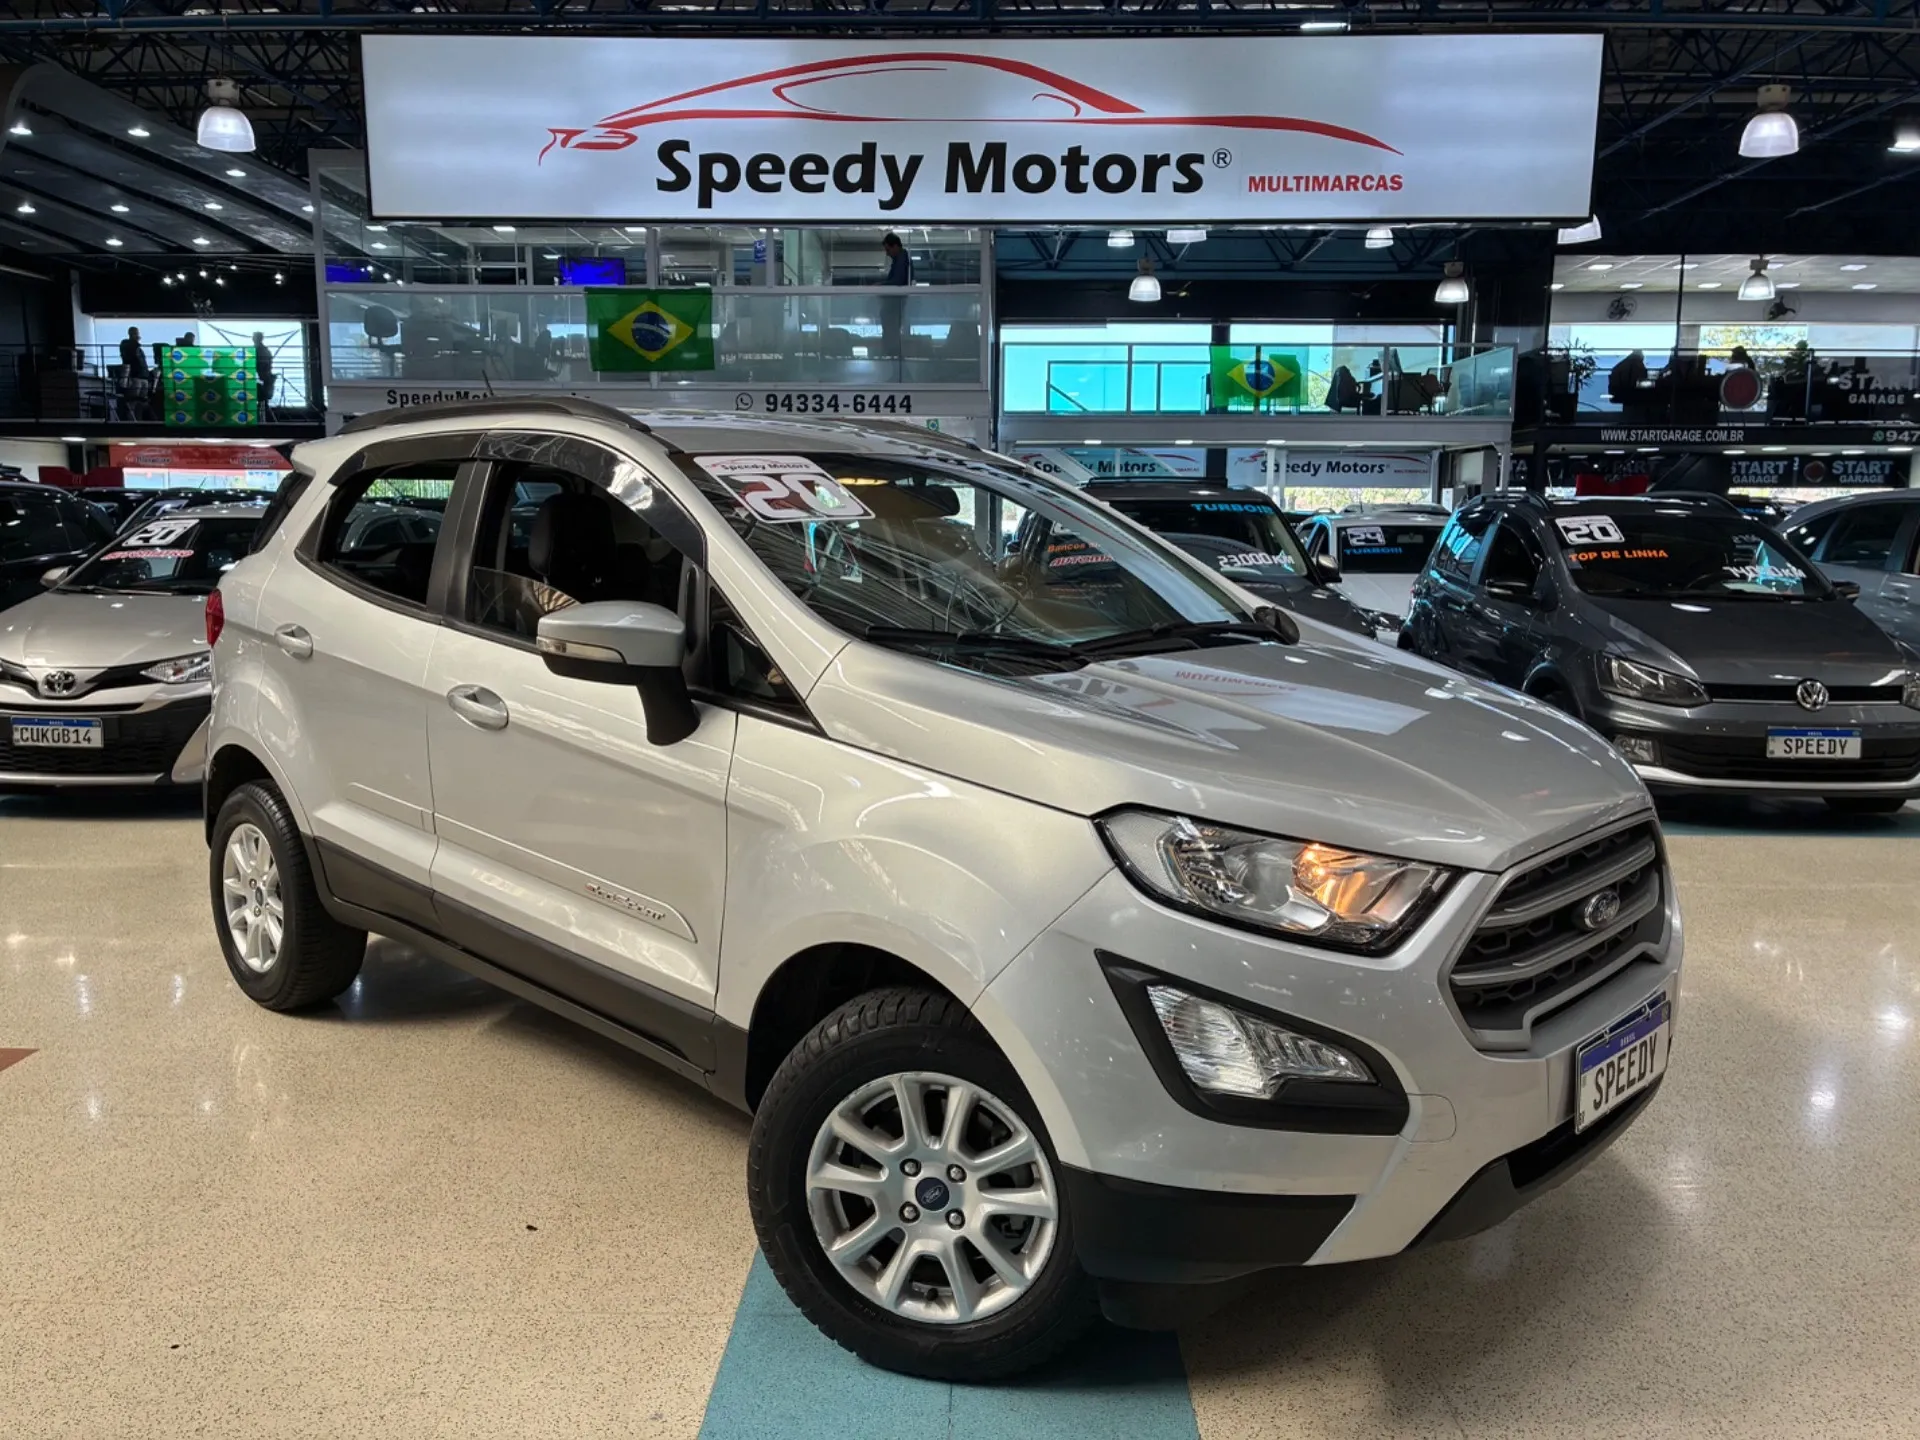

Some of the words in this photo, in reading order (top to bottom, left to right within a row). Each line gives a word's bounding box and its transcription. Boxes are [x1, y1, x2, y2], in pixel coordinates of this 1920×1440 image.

[656, 140, 923, 210] Speedy
[1248, 175, 1404, 192] MULTIMARCAS
[387, 390, 489, 408] SpeedM
[765, 393, 912, 413] 94334-6444
[1849, 394, 1905, 404] GARAGE
[1601, 430, 1744, 442] WWW.STARTGARAGE.COM.BR
[1326, 461, 1386, 473] Motors
[1832, 460, 1894, 474] START
[1839, 475, 1885, 483] GARAGE
[729, 474, 865, 517] 20
[128, 526, 186, 545] 20
[1564, 523, 1622, 543] 20
[1569, 551, 1598, 562] TOP
[1601, 550, 1620, 559] DE
[1624, 549, 1669, 559] LINHA
[1783, 738, 1848, 755] SPEEDY
[1593, 1032, 1658, 1110] SPEEDY
